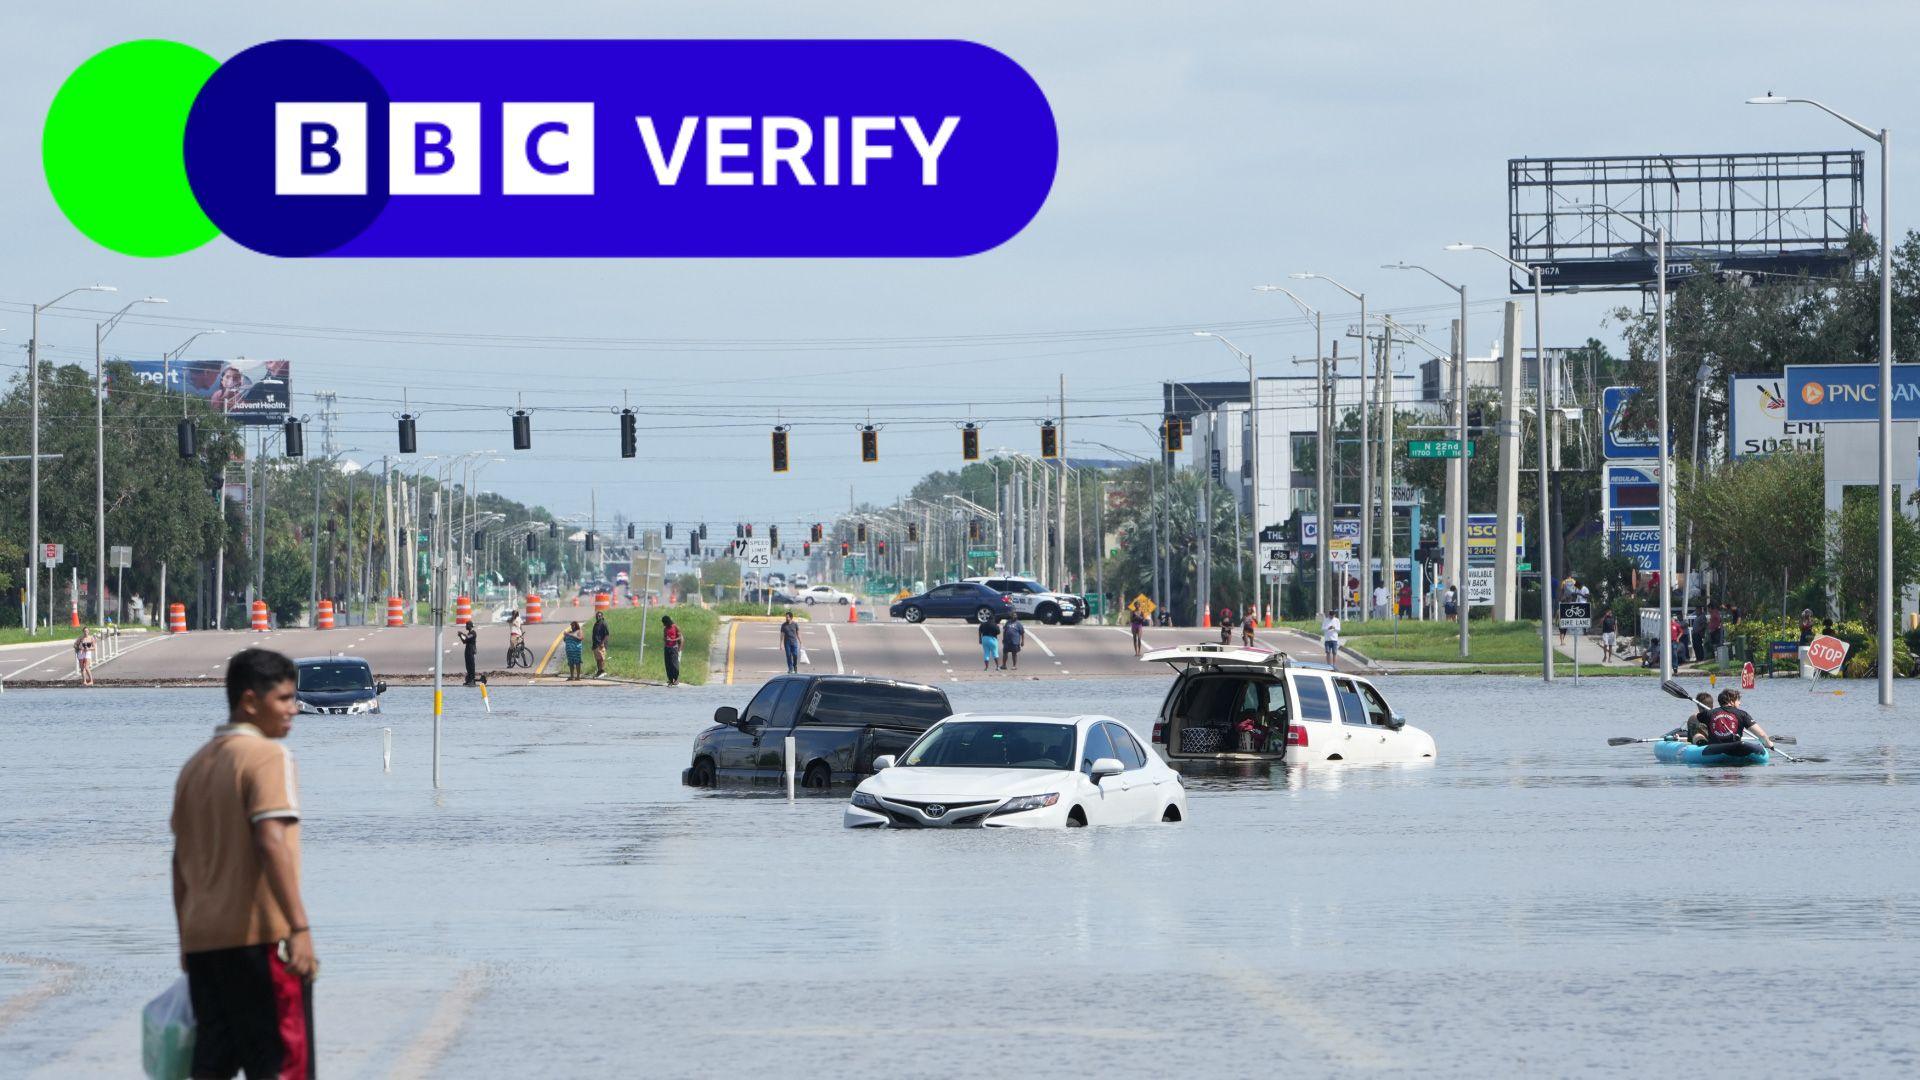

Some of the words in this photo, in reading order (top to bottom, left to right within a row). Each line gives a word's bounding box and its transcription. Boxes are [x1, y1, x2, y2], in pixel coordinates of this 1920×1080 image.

[1827, 383, 1877, 402] PNC
[1424, 442, 1431, 450] N
[1435, 442, 1459, 450] 22nd
[1306, 523, 1358, 535] CMPS
[1266, 531, 1284, 540] THE
[750, 554, 769, 565] 45
[1472, 579, 1488, 587] BACK
[1810, 643, 1843, 662] STOP
[1742, 673, 1755, 688] STOP
